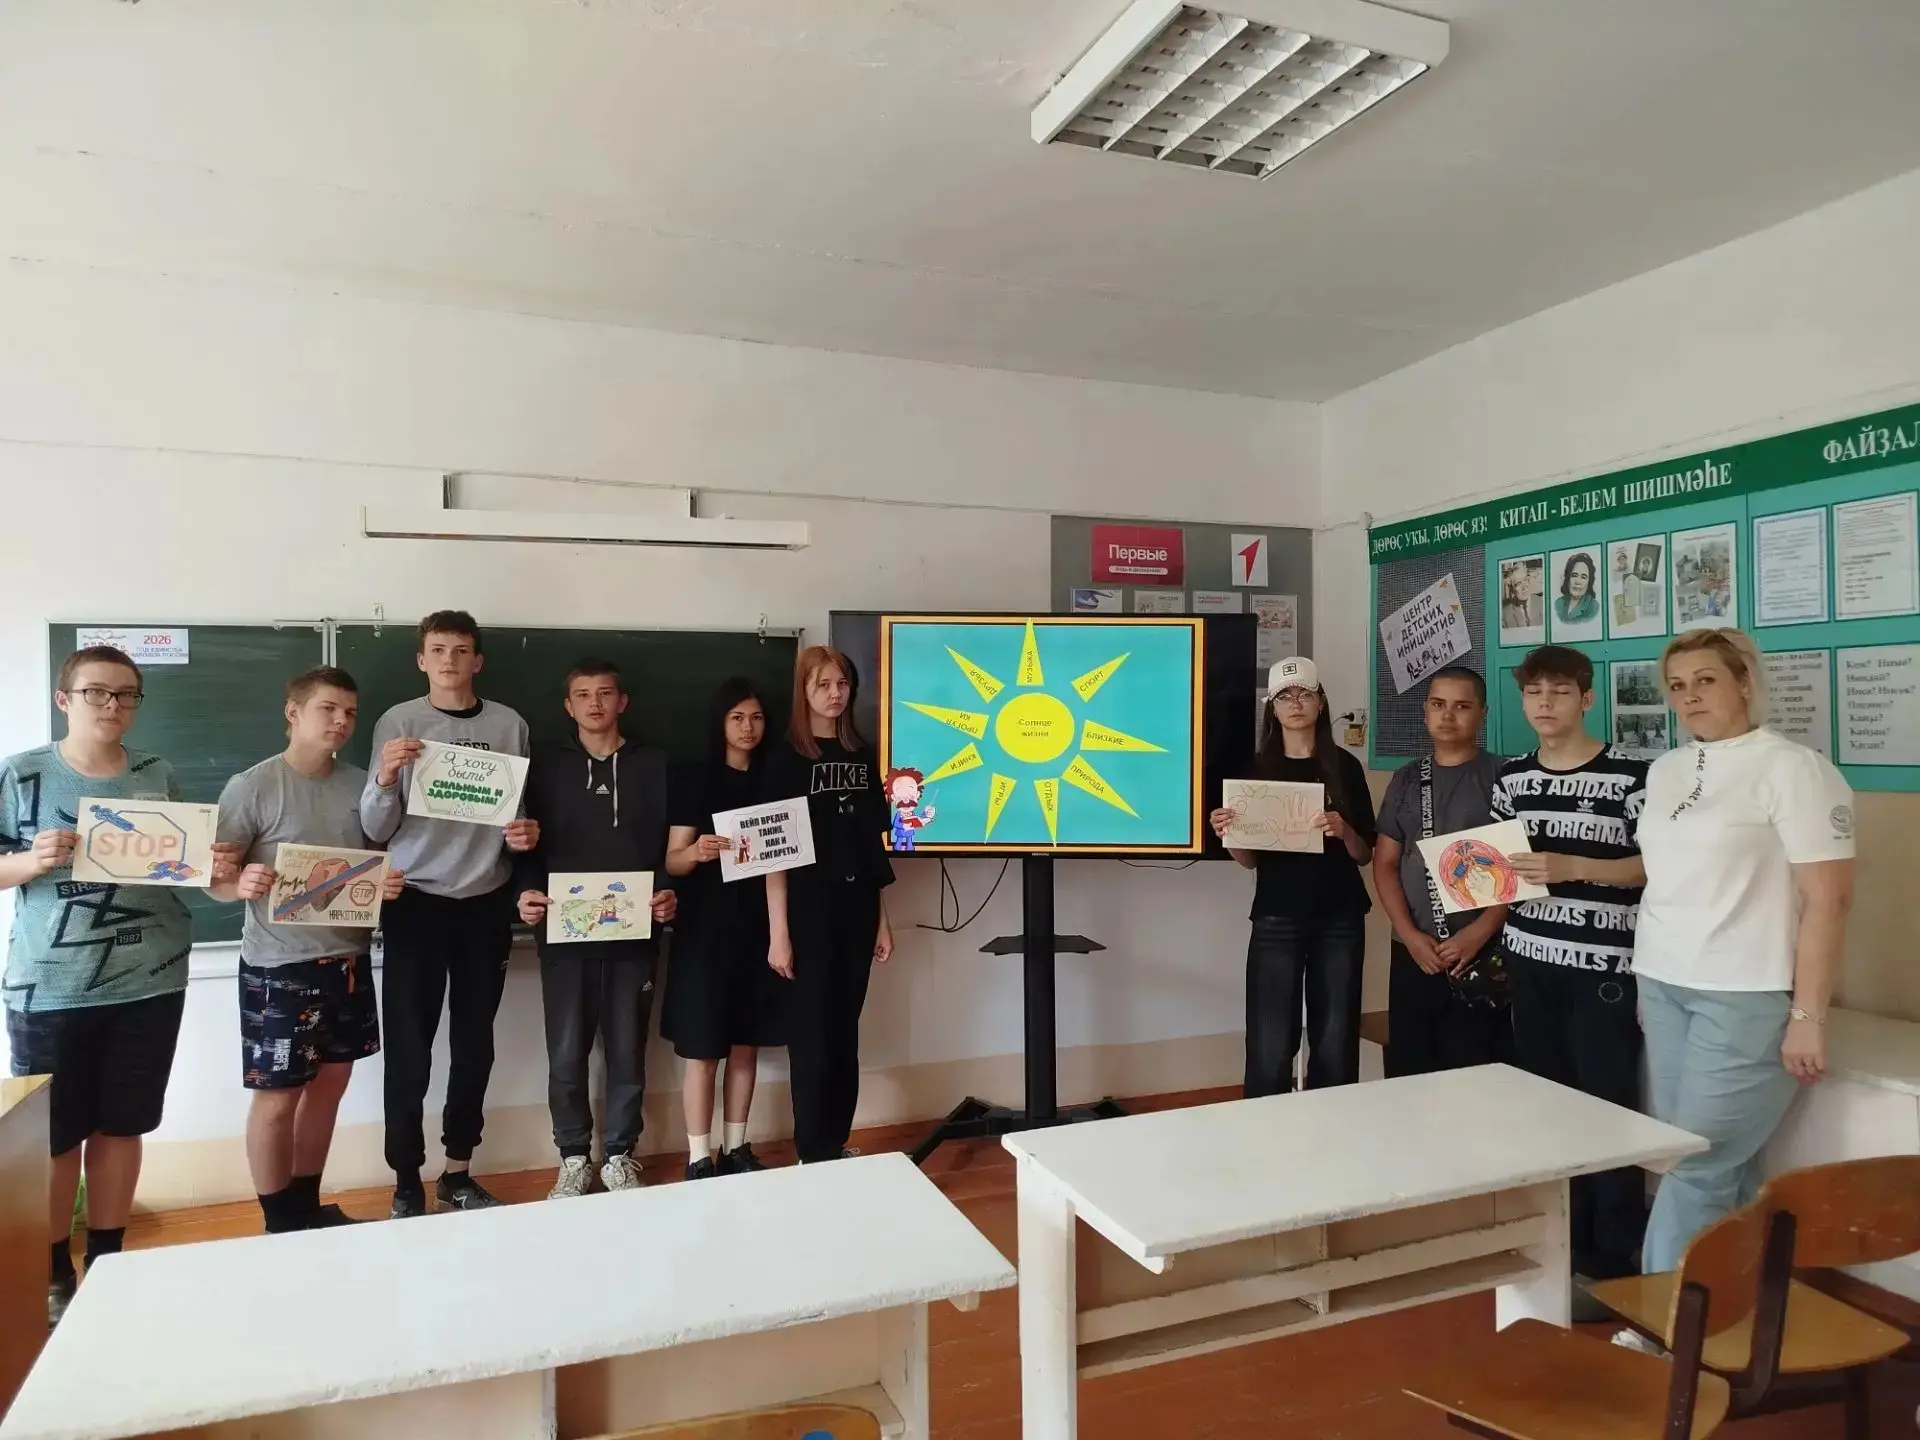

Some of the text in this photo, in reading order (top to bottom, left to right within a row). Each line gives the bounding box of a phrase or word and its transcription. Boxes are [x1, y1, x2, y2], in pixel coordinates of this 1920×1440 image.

[1499, 501, 1548, 529] КИТАП
[1559, 486, 1617, 517] БЕЛЕМ
[1108, 544, 1168, 564] Первые
[1403, 595, 1432, 623] ЦЕНТР
[1401, 604, 1444, 642] ДЕТСКИХ
[144, 635, 172, 645] 2026
[1396, 613, 1456, 659] ИНИЦИАТИВ
[969, 668, 998, 696] ДРУЗЬЯ
[1079, 670, 1105, 694] СПОРТ
[1018, 718, 1053, 729] Солнце
[1020, 730, 1049, 738] жизни
[1085, 732, 1126, 746] БЛИЗКИЕ
[441, 751, 497, 777] Я хочу
[949, 752, 977, 770] КНИГИ
[448, 764, 486, 782] быть
[811, 763, 868, 794] NIKE
[1070, 764, 1104, 794] ПРИРОДА
[427, 788, 498, 806] ЗДОРОВЫМ!
[432, 779, 504, 797] СИЛЬНЫМ И
[994, 781, 1007, 807] ИГРЫ
[1044, 781, 1055, 812] ОТДЫХ
[1546, 779, 1627, 802] ADIDAS
[740, 812, 790, 829] ВЕЙП ВРЕДЕН
[97, 832, 179, 858] STOP
[759, 846, 798, 861] СИГАРЕТЫ
[765, 836, 787, 848] КАК И
[353, 887, 374, 898] STOP
[329, 910, 373, 920] НАРКОТИКАМ
[1515, 902, 1586, 927] ADIDAS
[1507, 935, 1608, 972] ORIGINALS
